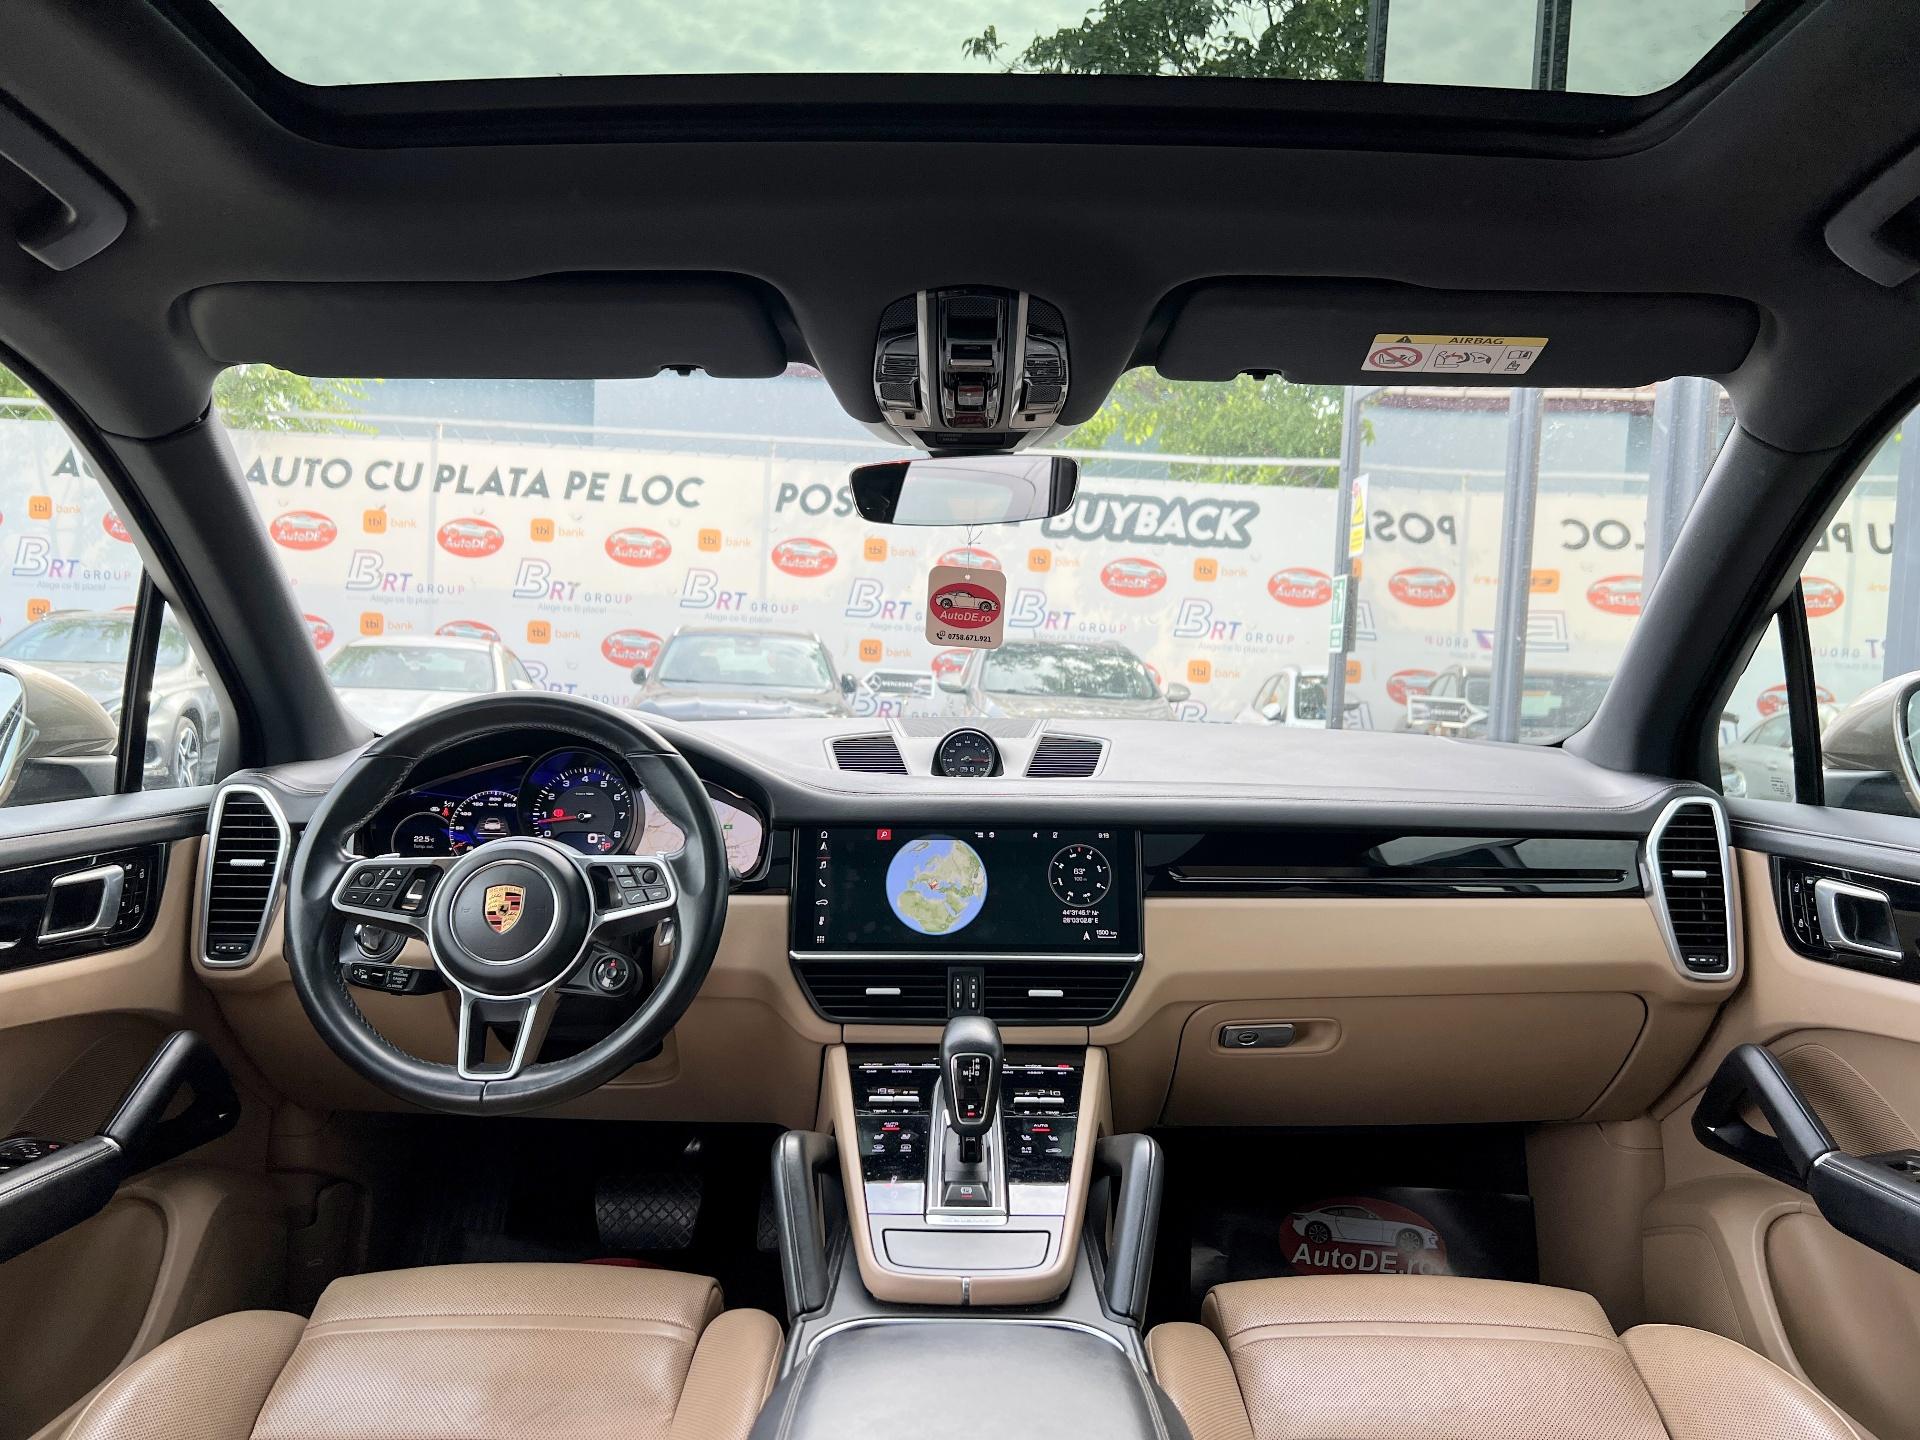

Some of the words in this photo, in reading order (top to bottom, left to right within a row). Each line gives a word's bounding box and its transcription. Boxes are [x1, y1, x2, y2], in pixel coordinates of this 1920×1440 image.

[1448, 336, 1505, 345] AIRBAG
[245, 455, 353, 490] AUTO
[364, 459, 424, 492] CU
[432, 463, 551, 499] PLATA
[563, 469, 611, 502] PE
[618, 472, 705, 508] LOC
[1045, 496, 1254, 545] BUYBACK
[83, 570, 131, 581] GROUP
[416, 583, 465, 595] GROUP
[584, 592, 633, 605] GROUP
[751, 602, 799, 615] GROUP
[940, 610, 992, 623] AutoDE.ro
[1079, 622, 1127, 634] GROUP
[947, 633, 992, 643] 0758.671.921
[1245, 633, 1295, 645] GROUP
